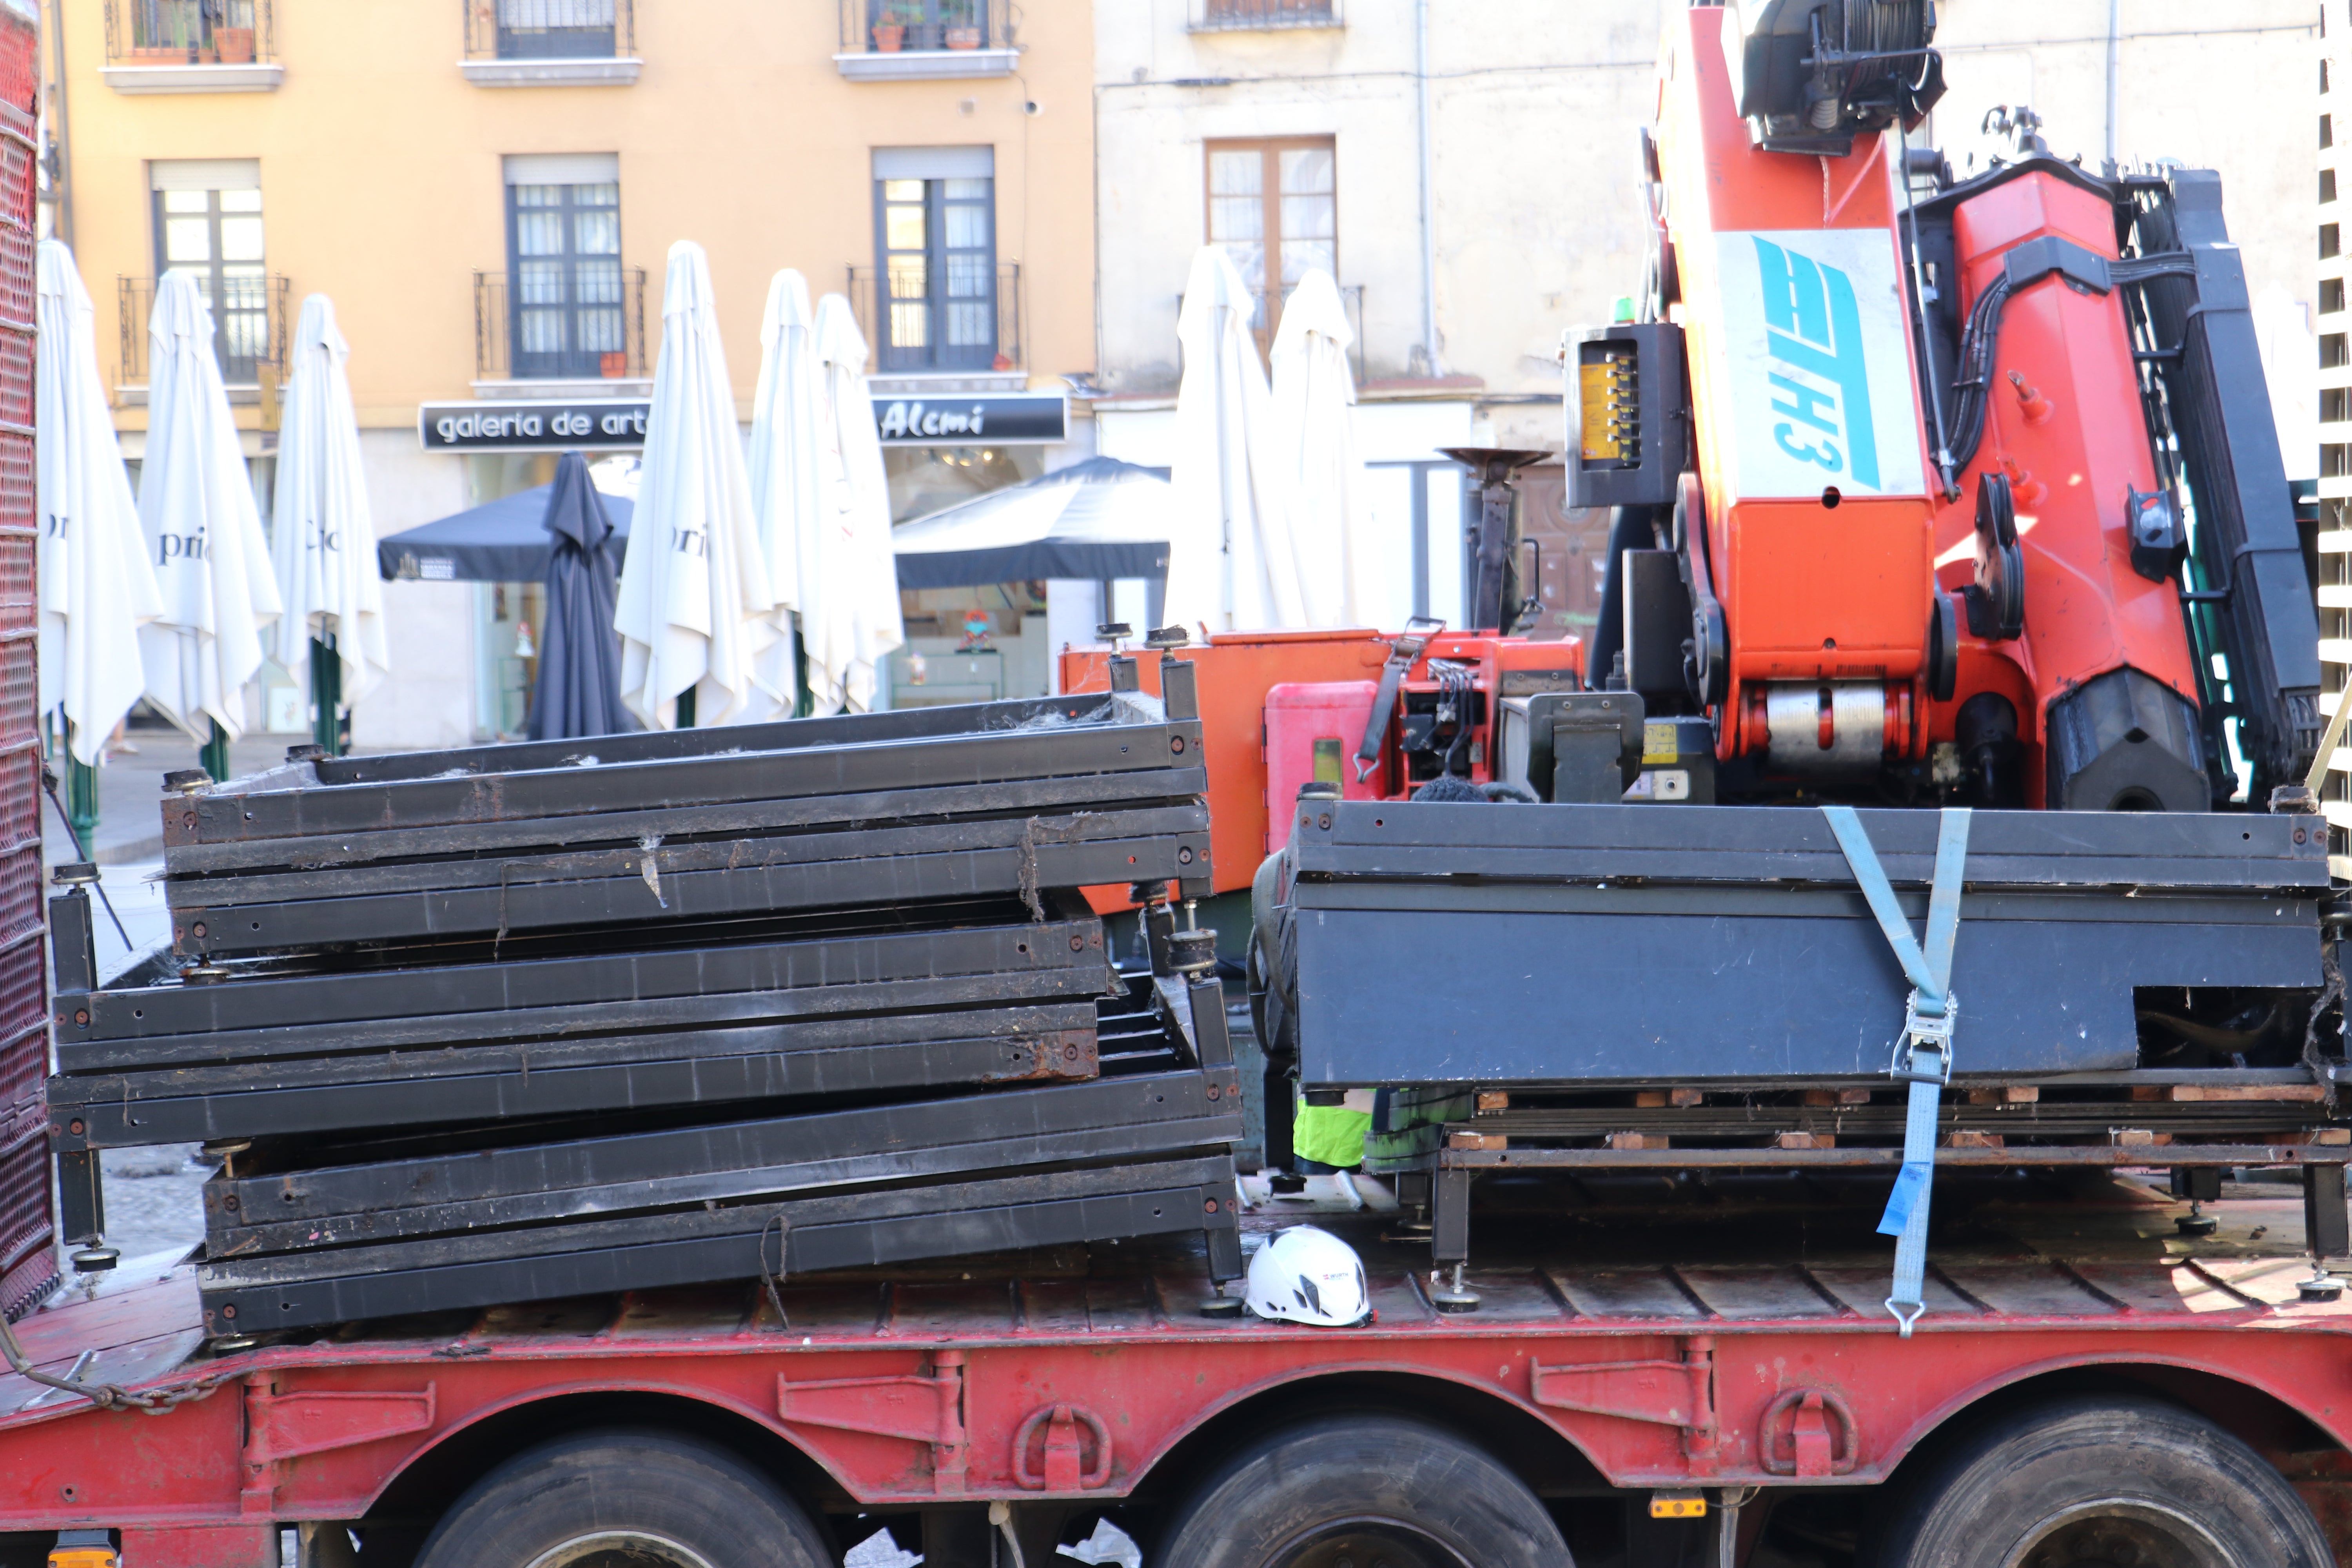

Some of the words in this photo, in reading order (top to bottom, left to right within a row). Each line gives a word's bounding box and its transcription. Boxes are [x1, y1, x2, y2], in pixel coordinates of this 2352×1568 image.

[437, 411, 543, 443] galeria
[551, 410, 593, 436] de
[601, 409, 649, 435] art
